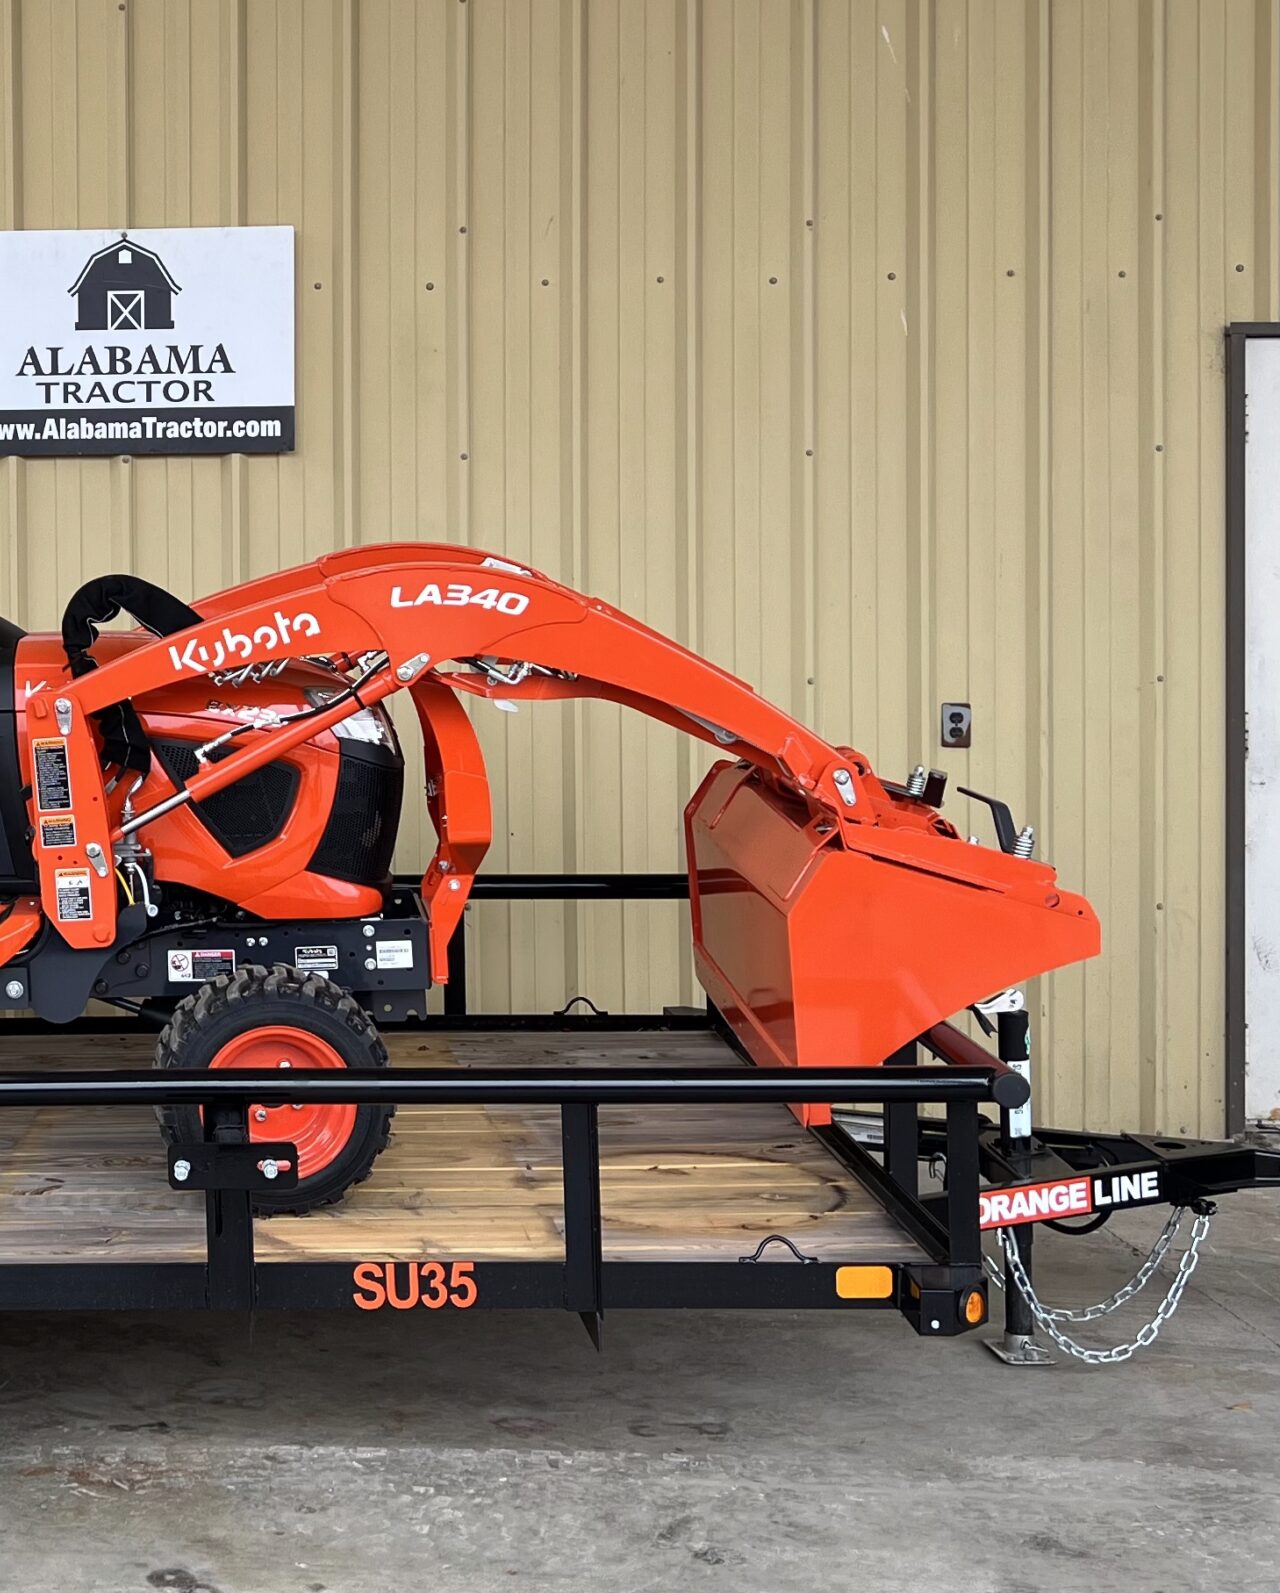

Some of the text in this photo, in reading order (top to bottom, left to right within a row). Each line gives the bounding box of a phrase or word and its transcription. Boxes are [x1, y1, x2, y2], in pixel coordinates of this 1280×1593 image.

[15, 343, 236, 377] ALABAMA
[35, 380, 215, 404] TRACTOR
[390, 583, 530, 616] LA340
[168, 610, 321, 672] Kubota
[1094, 1171, 1159, 1206] LINE
[353, 1262, 478, 1310] SU35
